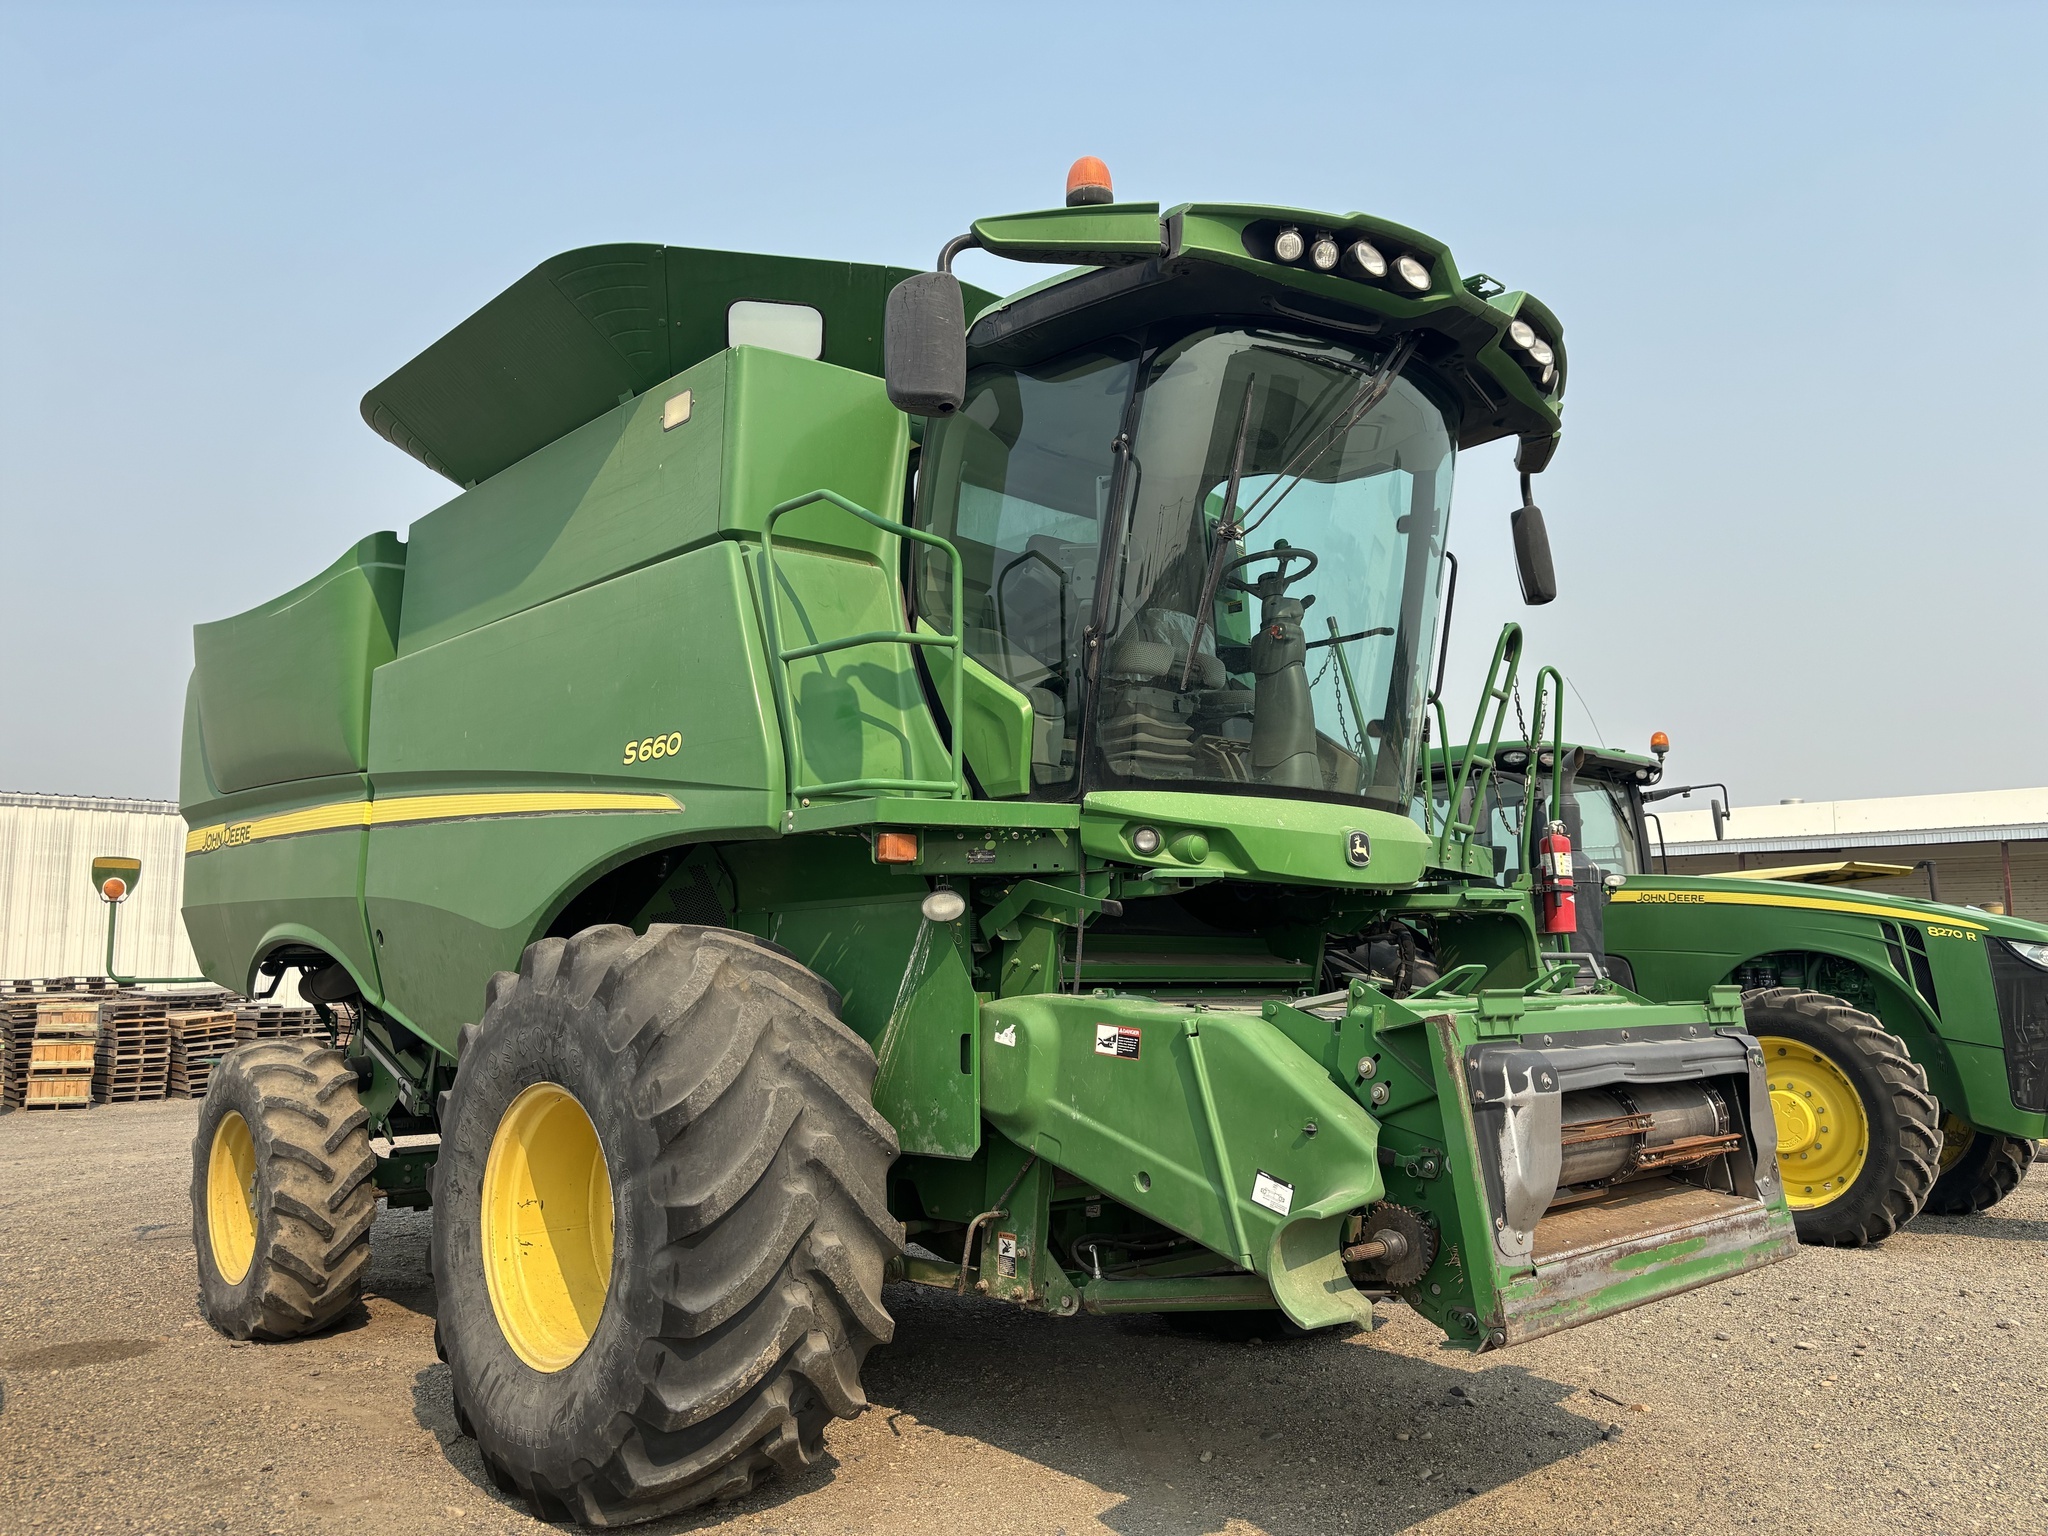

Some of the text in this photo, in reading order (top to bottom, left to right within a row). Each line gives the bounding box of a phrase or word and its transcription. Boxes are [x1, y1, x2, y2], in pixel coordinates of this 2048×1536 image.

[623, 730, 682, 766] S660
[202, 825, 251, 850] JOHN DEERE
[1637, 892, 1705, 902] JOHN DEERE
[1927, 926, 1977, 941] 8270 R
